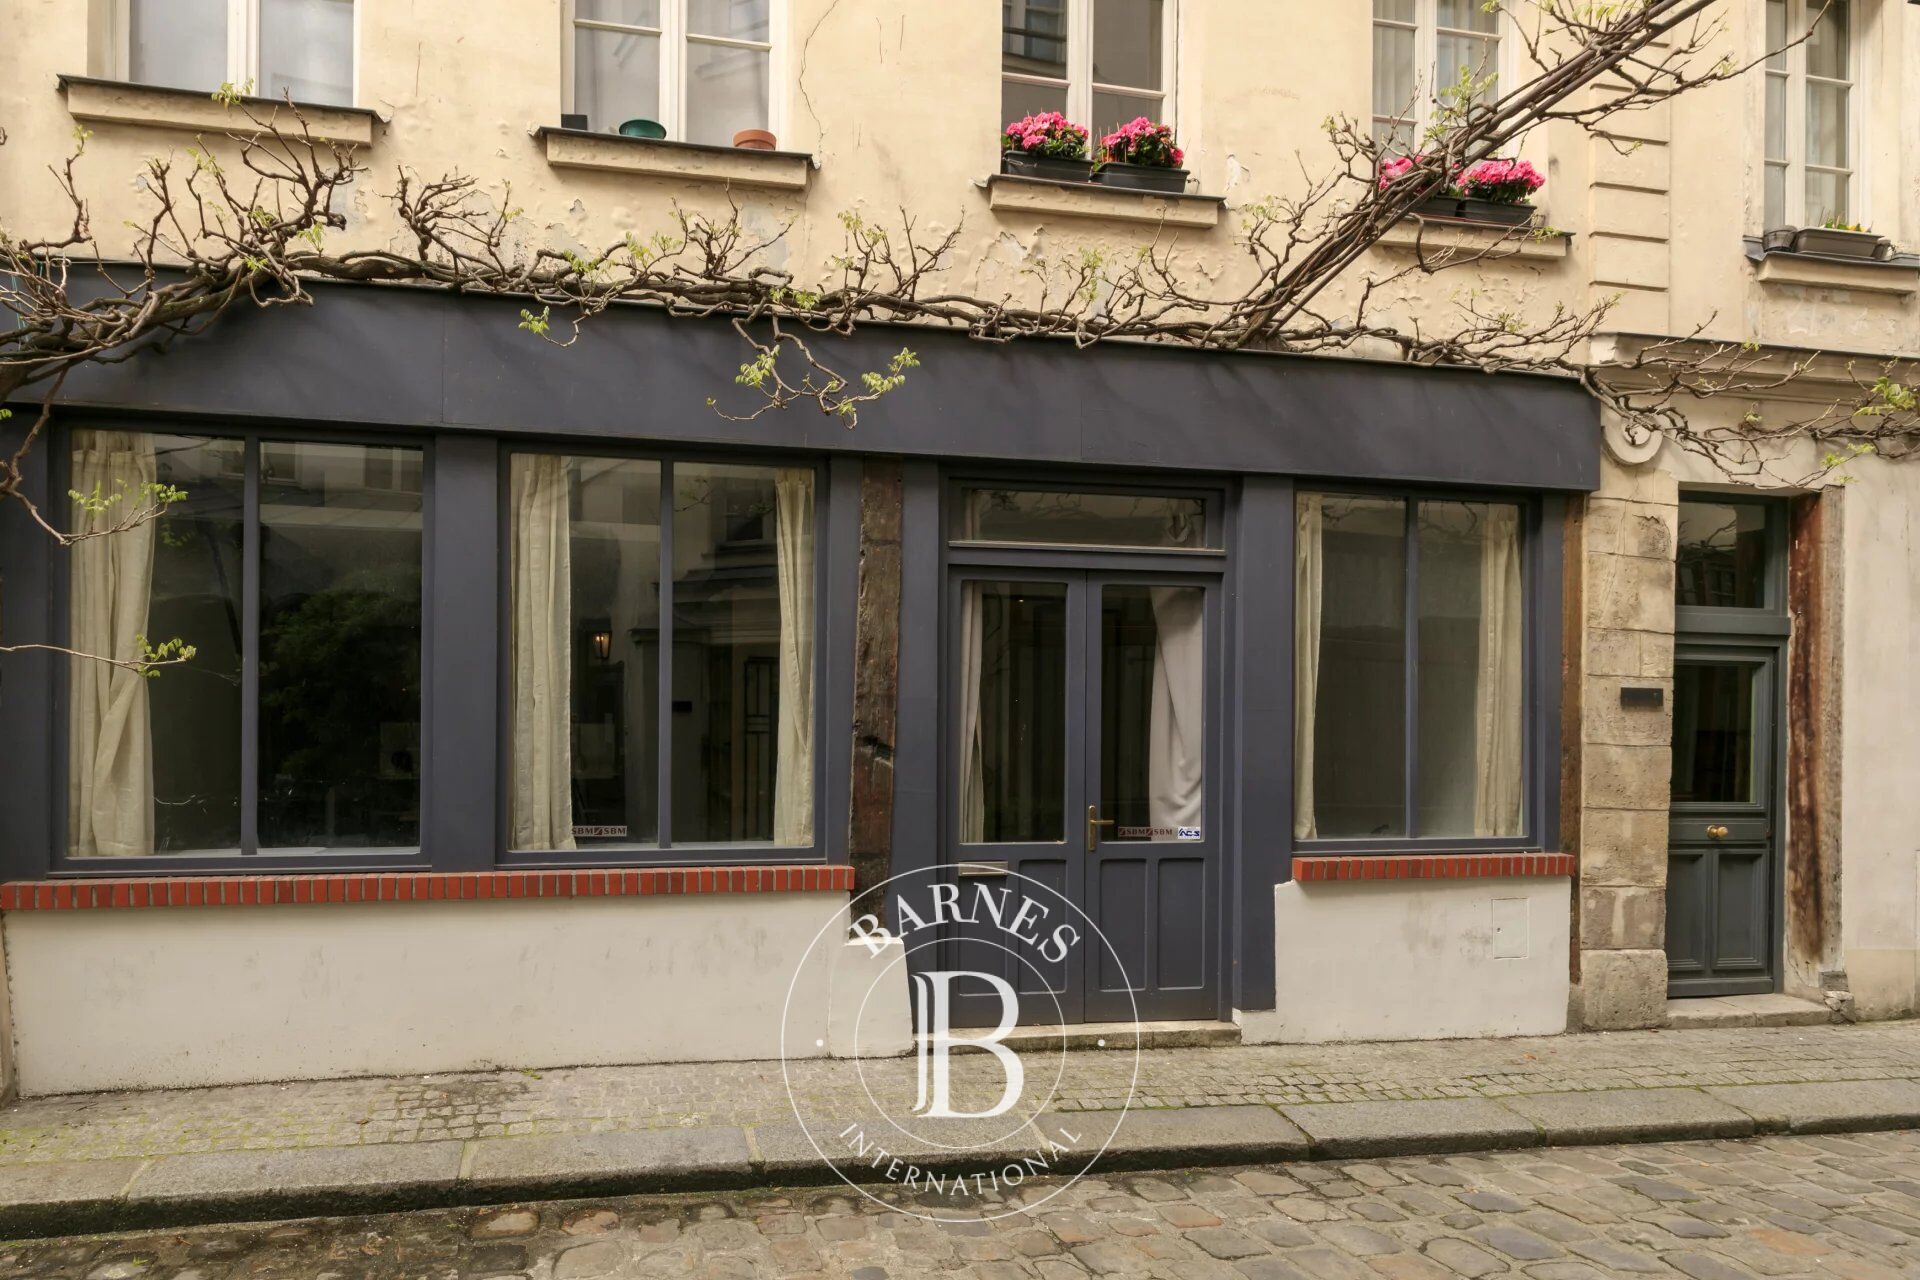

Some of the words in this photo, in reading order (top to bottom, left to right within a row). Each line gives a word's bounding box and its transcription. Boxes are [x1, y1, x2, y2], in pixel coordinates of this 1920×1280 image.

[572, 827, 593, 835] SBM
[603, 827, 626, 835] SBM
[1154, 828, 1173, 836] SBM
